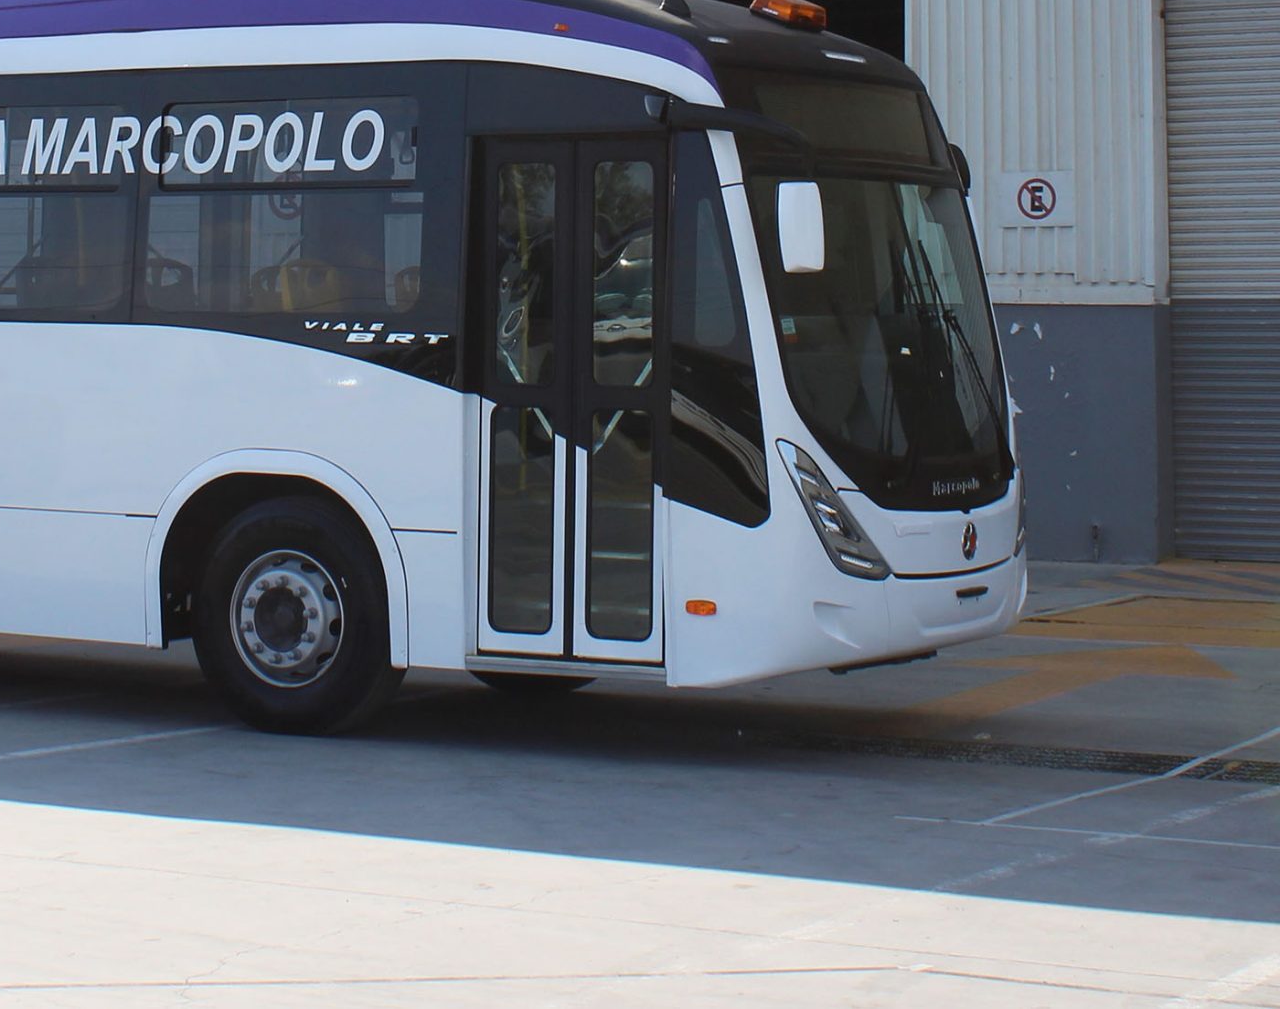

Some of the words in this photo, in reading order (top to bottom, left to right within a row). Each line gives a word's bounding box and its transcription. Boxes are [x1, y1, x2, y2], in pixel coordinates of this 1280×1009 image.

[20, 109, 386, 176] MARCOPOLO
[304, 321, 385, 331] VIALE
[346, 332, 449, 344] BRT
